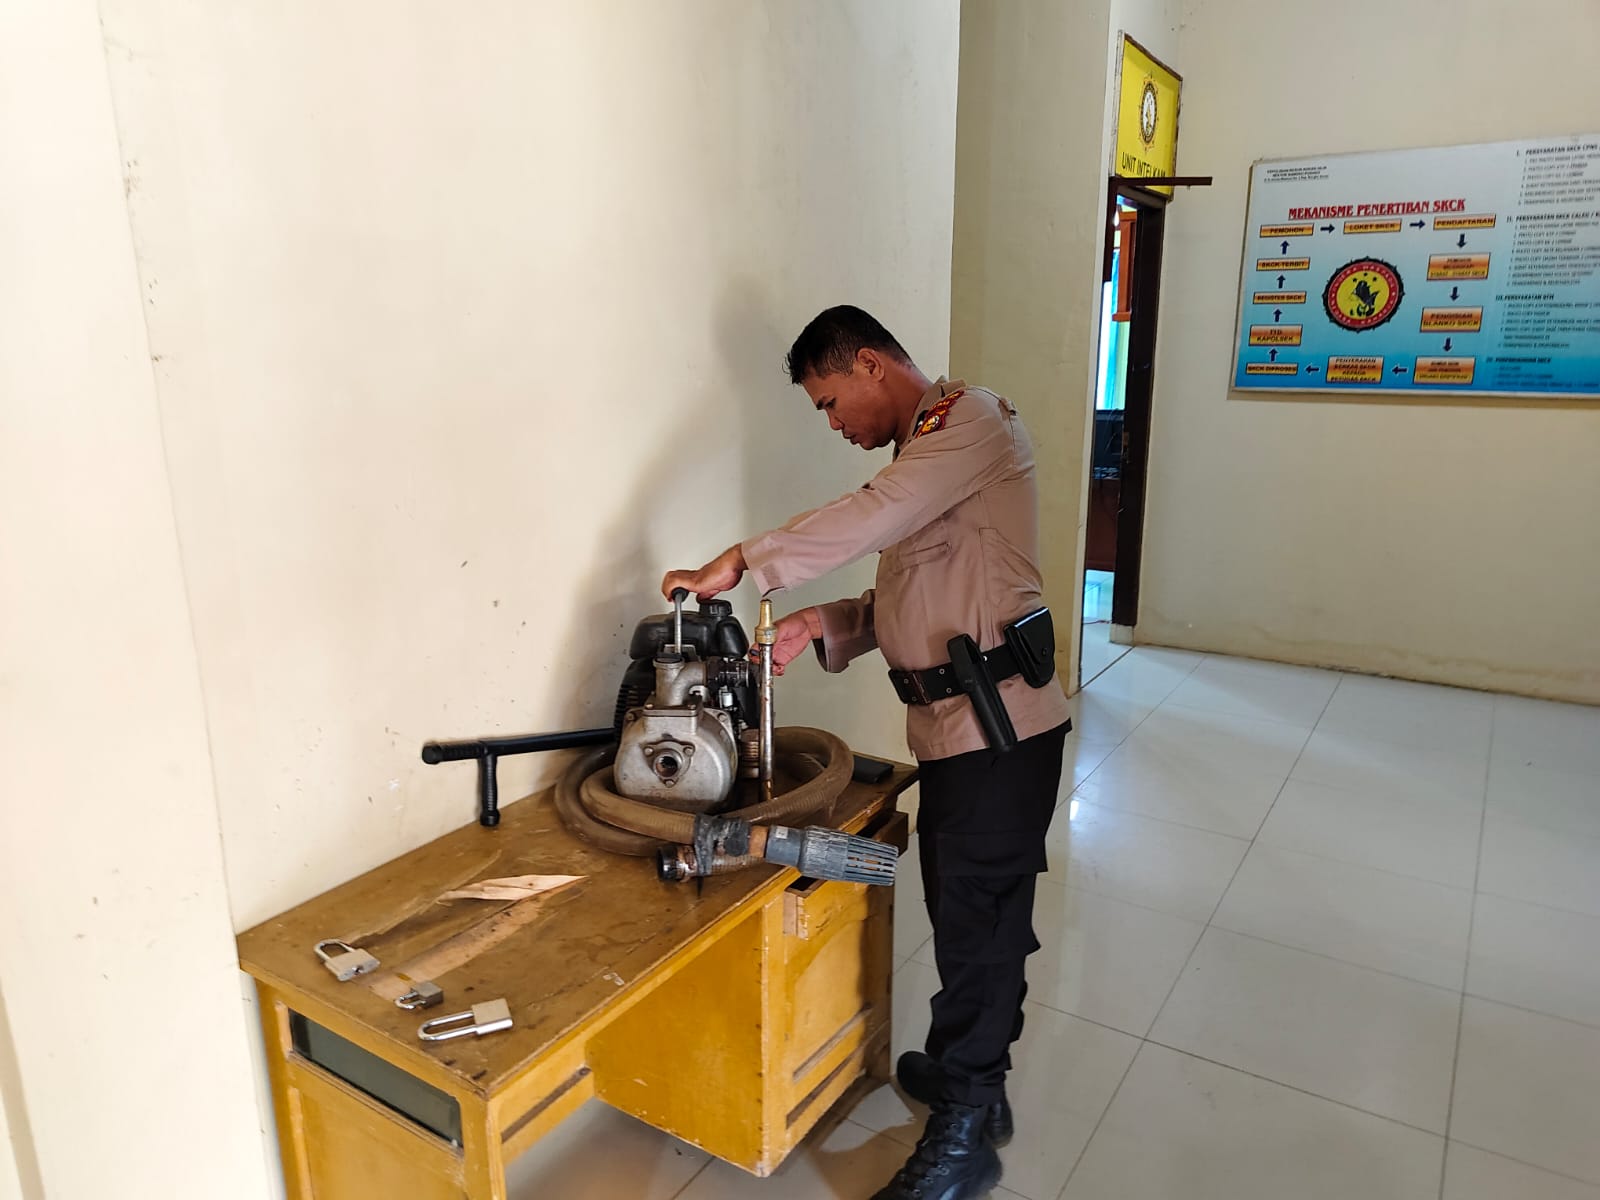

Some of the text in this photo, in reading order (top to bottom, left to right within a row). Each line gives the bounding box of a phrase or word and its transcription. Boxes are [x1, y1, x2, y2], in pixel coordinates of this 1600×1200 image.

[1122, 151, 1136, 173] UNIT
[1288, 198, 1466, 220] MEKANISME PENERTIBAN SKCK
[1436, 217, 1494, 226] PENDAFTARAN
[1269, 226, 1305, 234] PEMOHON
